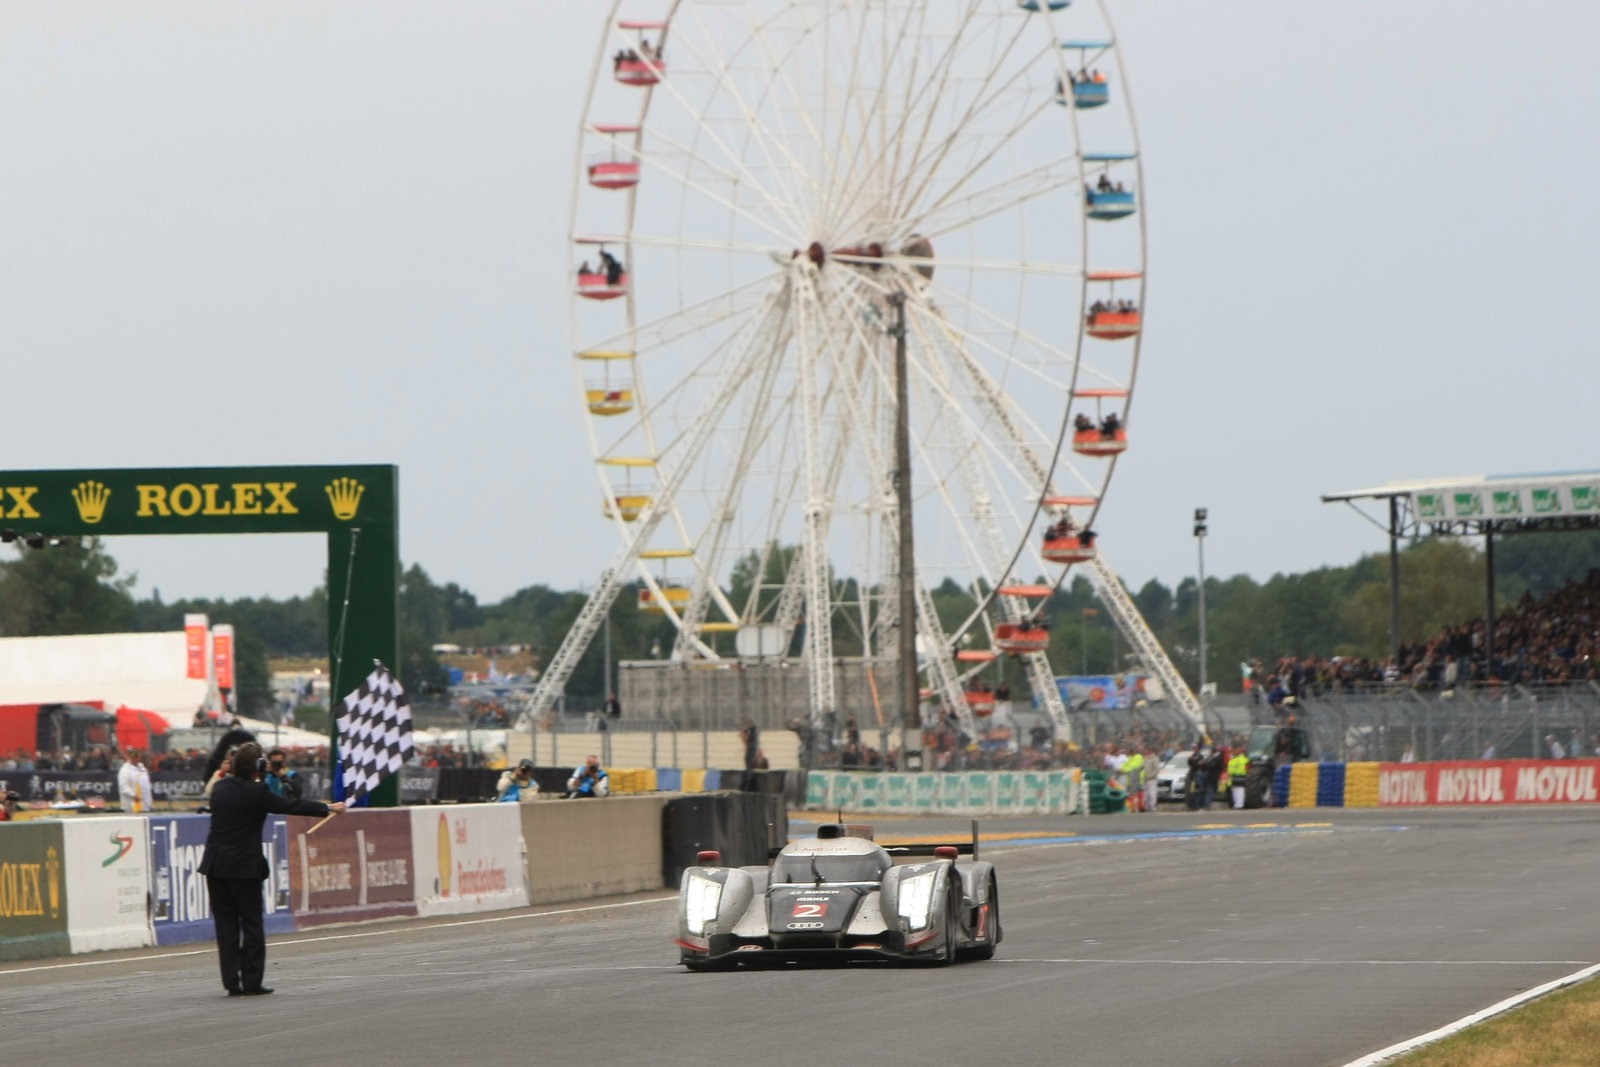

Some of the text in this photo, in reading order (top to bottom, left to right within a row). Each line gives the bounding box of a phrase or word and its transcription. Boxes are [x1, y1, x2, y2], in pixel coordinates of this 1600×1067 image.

[136, 482, 299, 517] ROLEX
[44, 780, 113, 794] PEUGEOT
[1437, 766, 1505, 803] MOTUL
[1515, 765, 1597, 802] MOTUL
[0, 862, 44, 918] OLEX
[794, 904, 822, 918] 2
